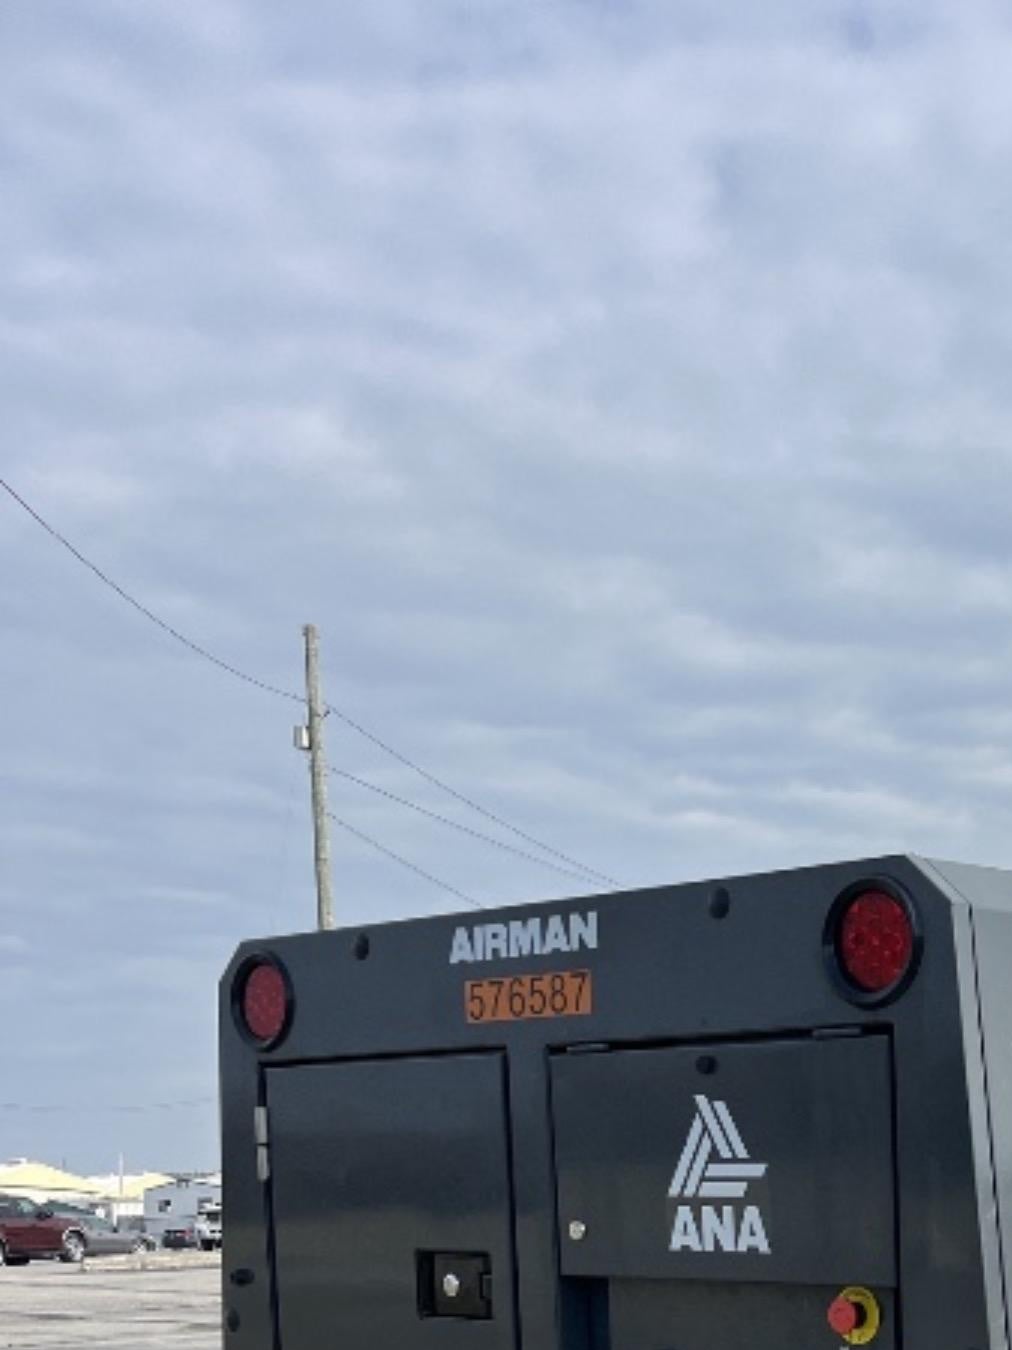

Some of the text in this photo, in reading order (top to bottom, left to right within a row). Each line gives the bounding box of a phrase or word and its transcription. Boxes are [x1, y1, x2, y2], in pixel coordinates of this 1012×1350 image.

[450, 911, 598, 963] AIRMAN
[469, 971, 587, 1020] 576587
[669, 1205, 771, 1254] ANA
